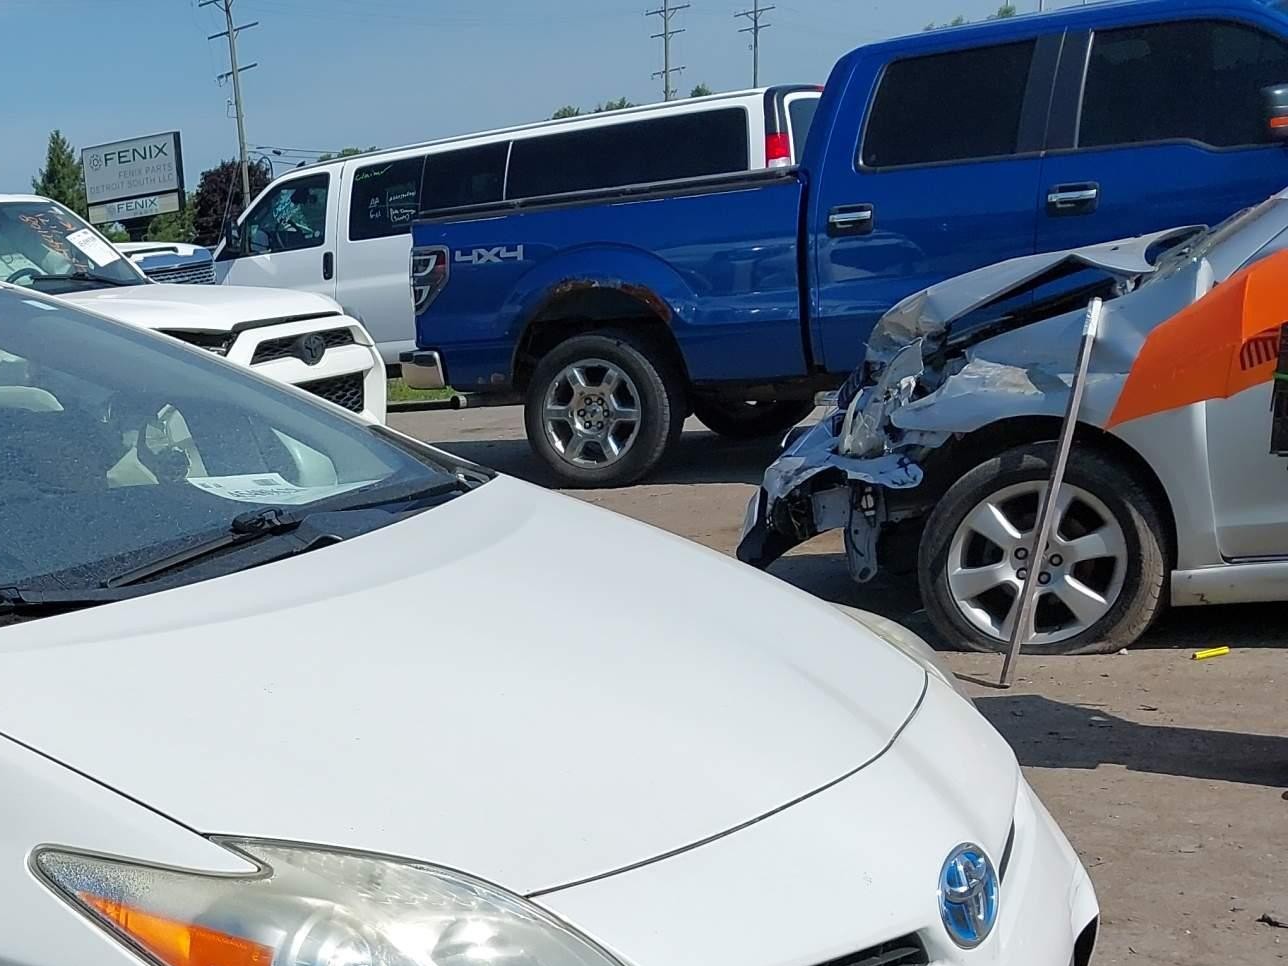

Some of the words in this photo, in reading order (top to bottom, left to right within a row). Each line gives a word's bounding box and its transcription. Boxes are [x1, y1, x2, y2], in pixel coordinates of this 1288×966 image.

[104, 142, 168, 167] FENIX
[118, 168, 143, 179] FENIX
[145, 162, 172, 174] PARTS
[90, 181, 124, 194] DETROIT
[127, 175, 157, 189] SOUTH
[116, 197, 158, 213] FENIX
